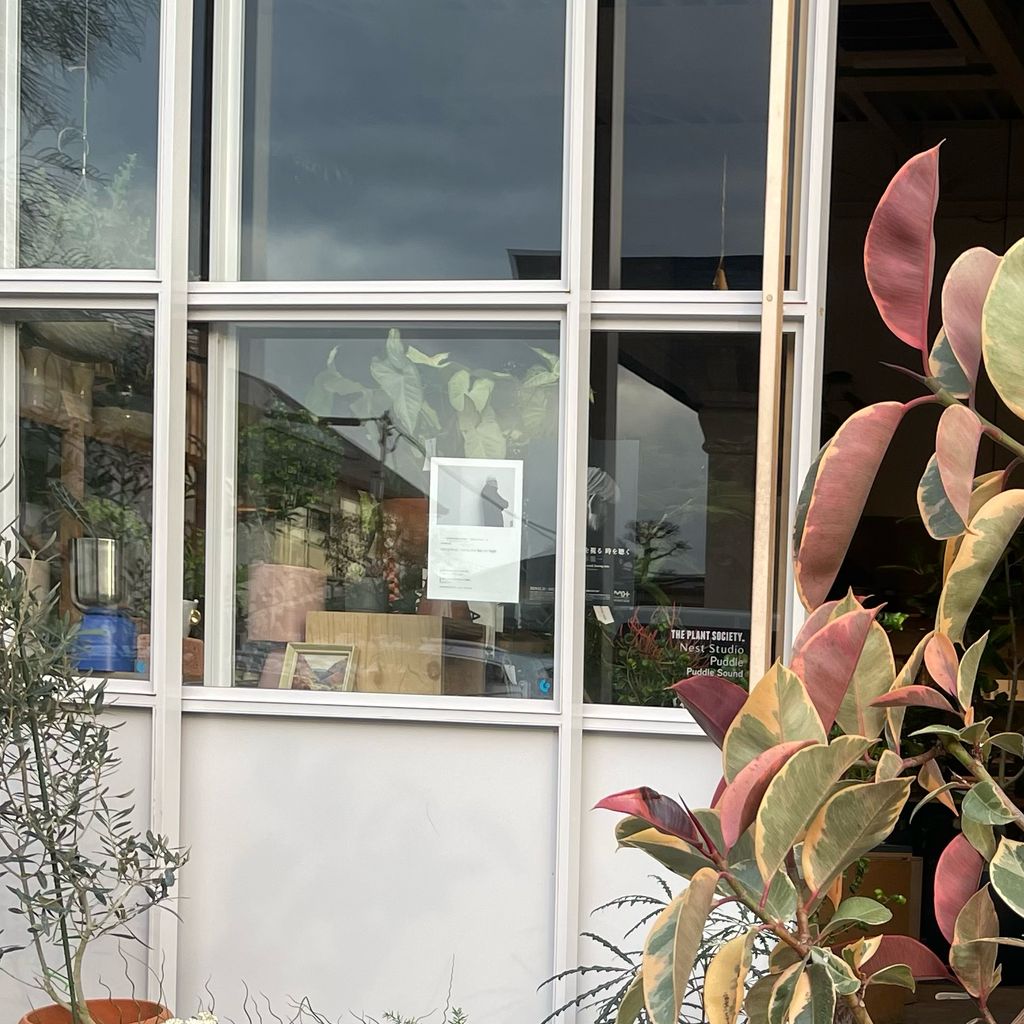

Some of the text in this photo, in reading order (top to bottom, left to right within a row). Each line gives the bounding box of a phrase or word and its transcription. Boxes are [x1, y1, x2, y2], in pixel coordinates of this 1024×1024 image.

[671, 630, 686, 640] THE
[686, 630, 710, 640] PLANT
[680, 643, 744, 654] Nest Studio
[710, 656, 744, 666] Puddle
[686, 668, 744, 678] Puddle Sound
